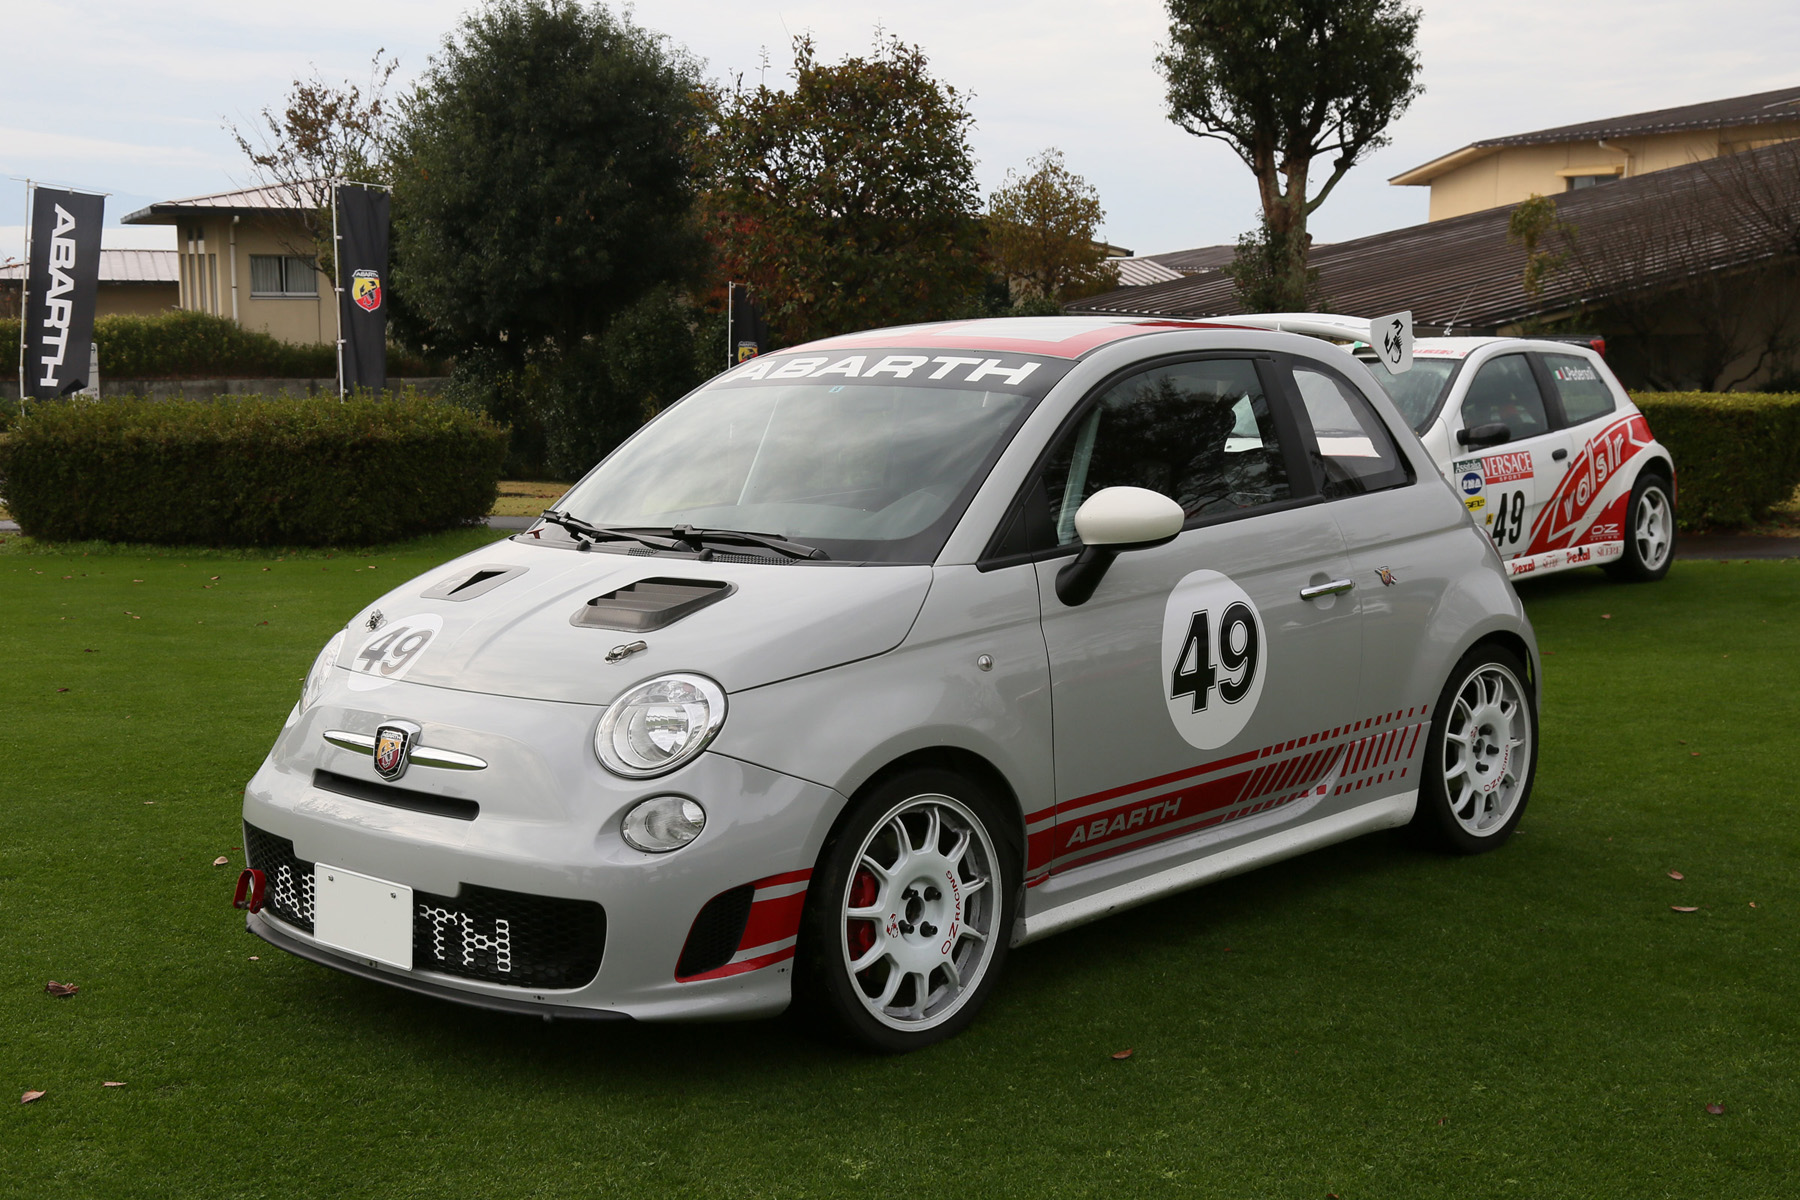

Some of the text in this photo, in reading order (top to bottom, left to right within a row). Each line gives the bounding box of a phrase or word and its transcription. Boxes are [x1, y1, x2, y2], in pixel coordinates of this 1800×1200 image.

[40, 203, 76, 386] ABARTH
[720, 355, 1041, 385] ABARTH
[1481, 453, 1533, 477] VERSACE
[1499, 474, 1521, 482] SPORT
[1492, 490, 1525, 546] 49
[358, 626, 434, 677] 49
[1170, 601, 1260, 714] 49
[1065, 798, 1182, 848] ABARTH
[946, 870, 961, 921] RACING
